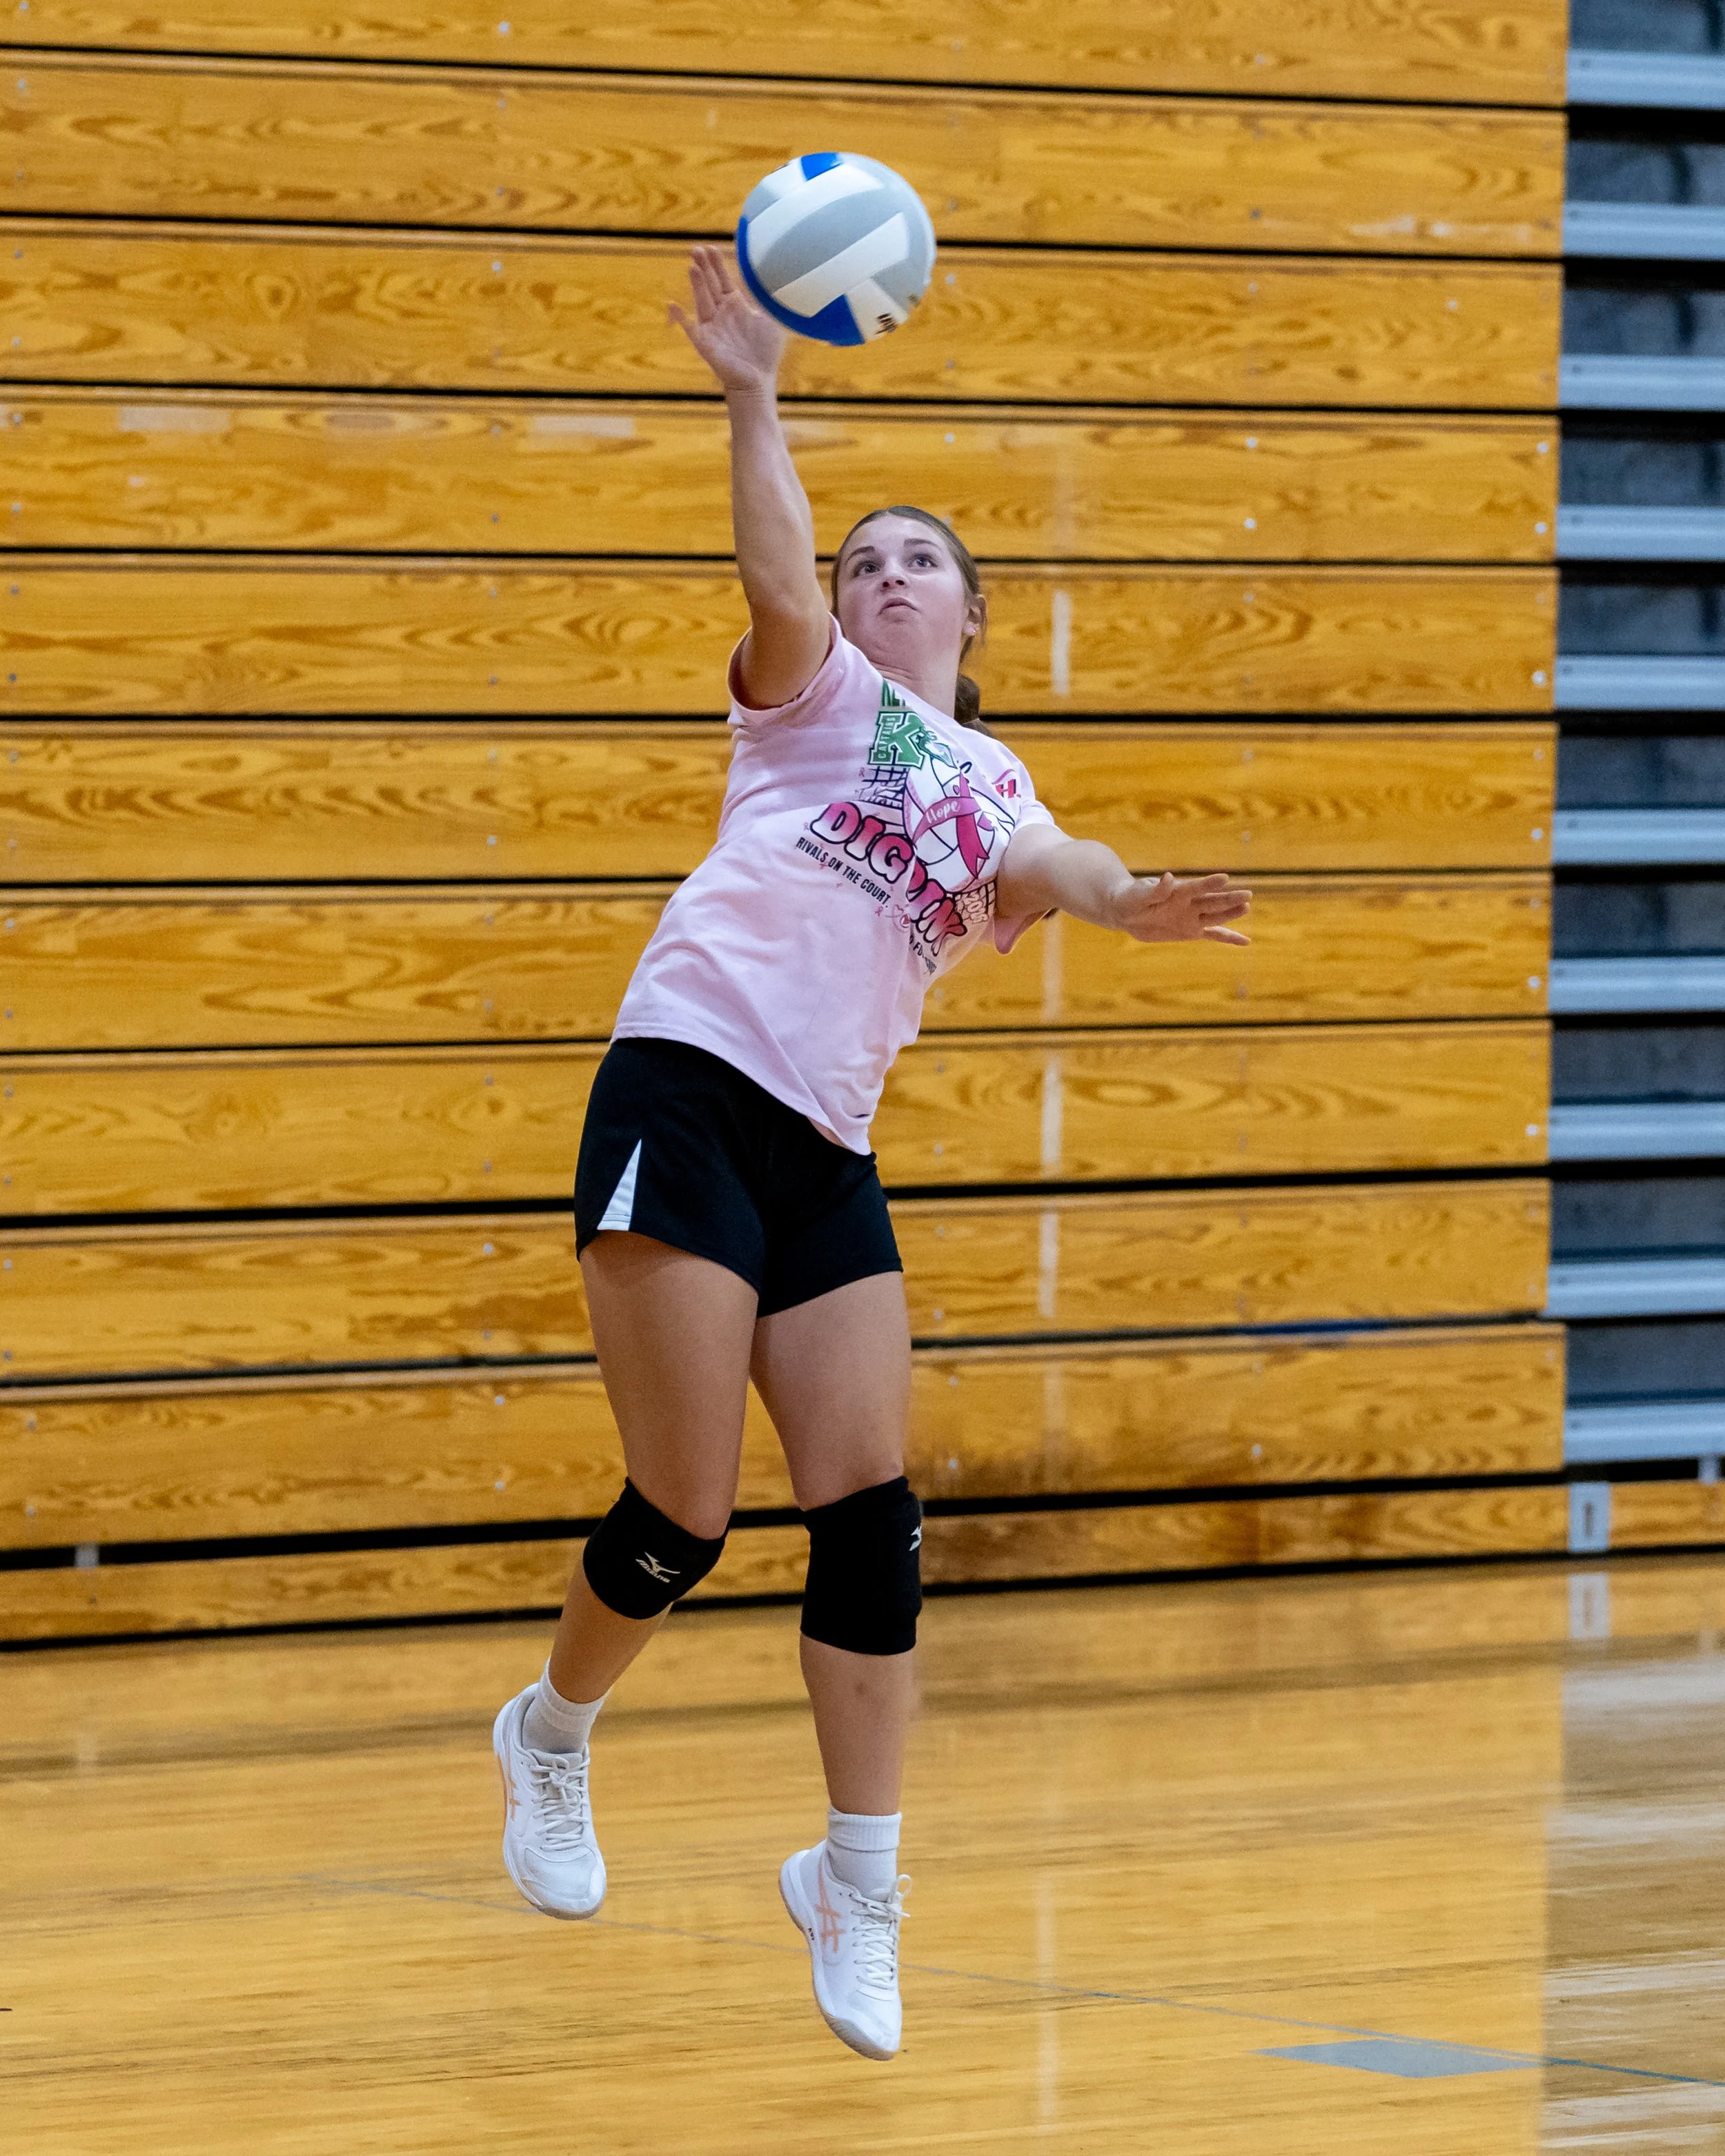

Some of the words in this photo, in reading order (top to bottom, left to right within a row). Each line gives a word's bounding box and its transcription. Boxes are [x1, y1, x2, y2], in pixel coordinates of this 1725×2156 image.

[867, 711, 925, 771] K
[878, 717, 896, 759] CAPTAINS
[795, 836, 829, 863] RIVALS
[828, 857, 844, 871] ON
[842, 865, 862, 884] THE
[809, 801, 916, 884] DIG
